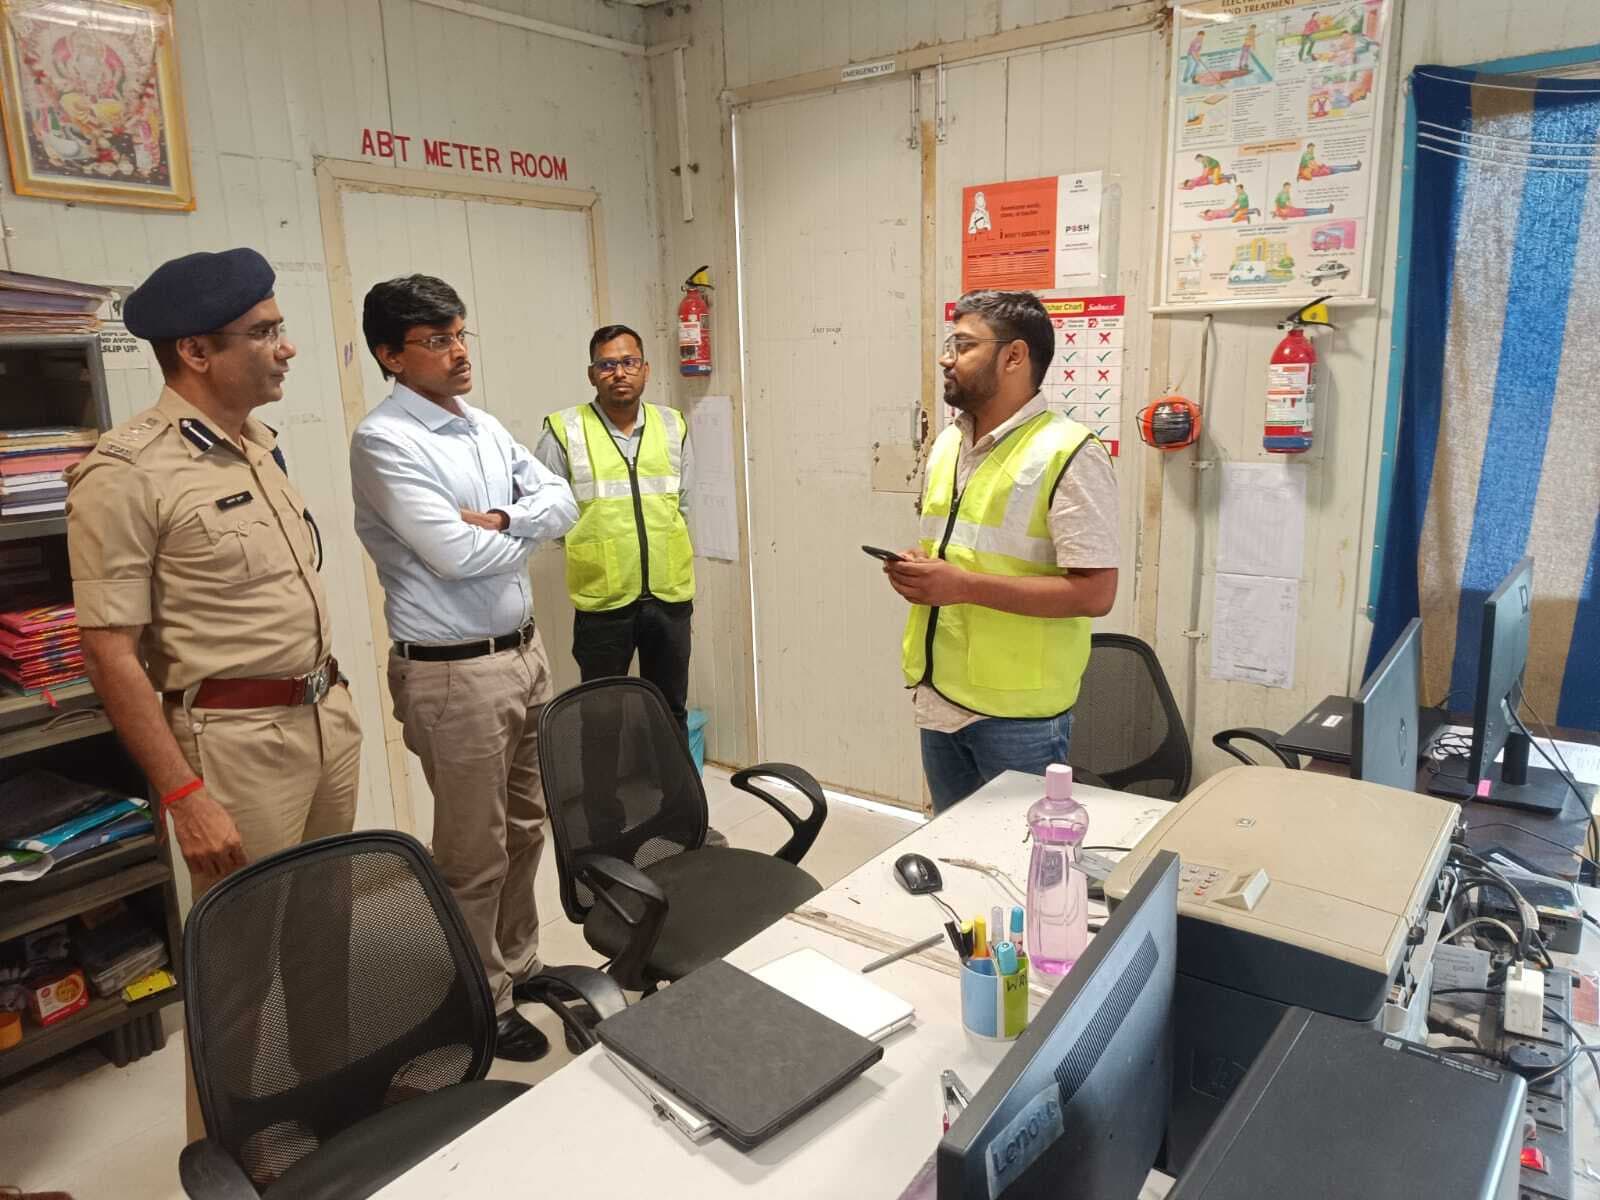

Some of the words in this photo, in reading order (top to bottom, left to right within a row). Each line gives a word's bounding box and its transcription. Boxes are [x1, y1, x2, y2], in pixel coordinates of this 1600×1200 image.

[1244, 0, 1295, 13] TREATMENT
[842, 65, 879, 78] EMERGENCY
[880, 63, 893, 72] EXIT
[361, 128, 410, 162] ABT
[423, 138, 502, 173] METER
[509, 151, 568, 181] ROOM
[1064, 303, 1082, 311] Chart
[102, 345, 122, 353] SLIP
[992, 1098, 1059, 1175] Lenovo
